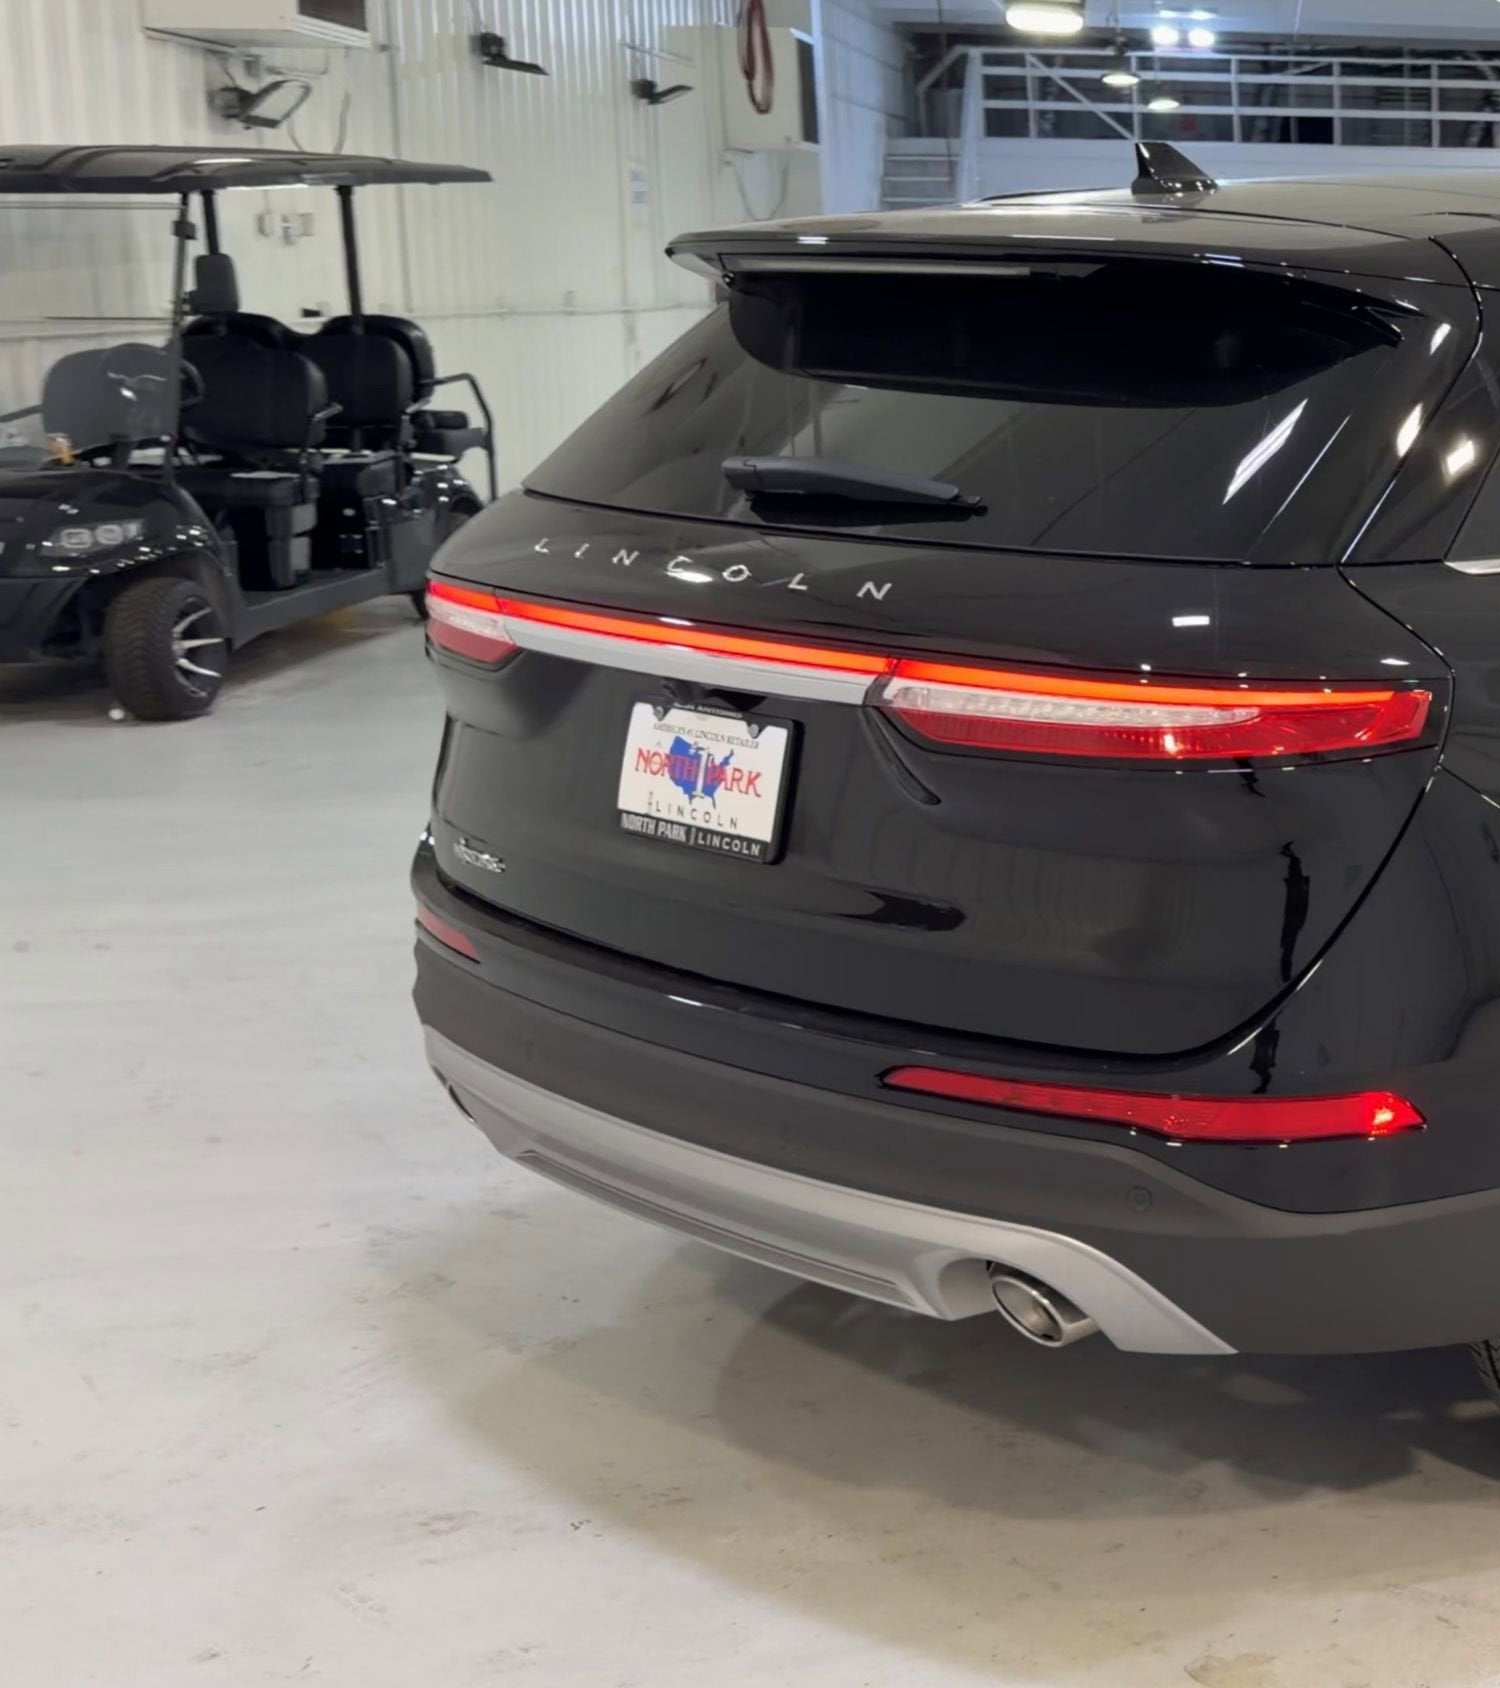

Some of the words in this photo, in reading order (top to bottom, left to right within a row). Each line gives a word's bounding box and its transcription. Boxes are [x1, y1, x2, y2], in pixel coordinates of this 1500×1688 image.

[534, 537, 892, 600] LINCOLN
[634, 747, 699, 784] NORTH
[706, 763, 762, 798] PARK
[620, 812, 656, 835] NORTH
[657, 820, 688, 842] PARK
[697, 831, 761, 856] LINCOLN
[656, 799, 738, 830] LINCOLN
